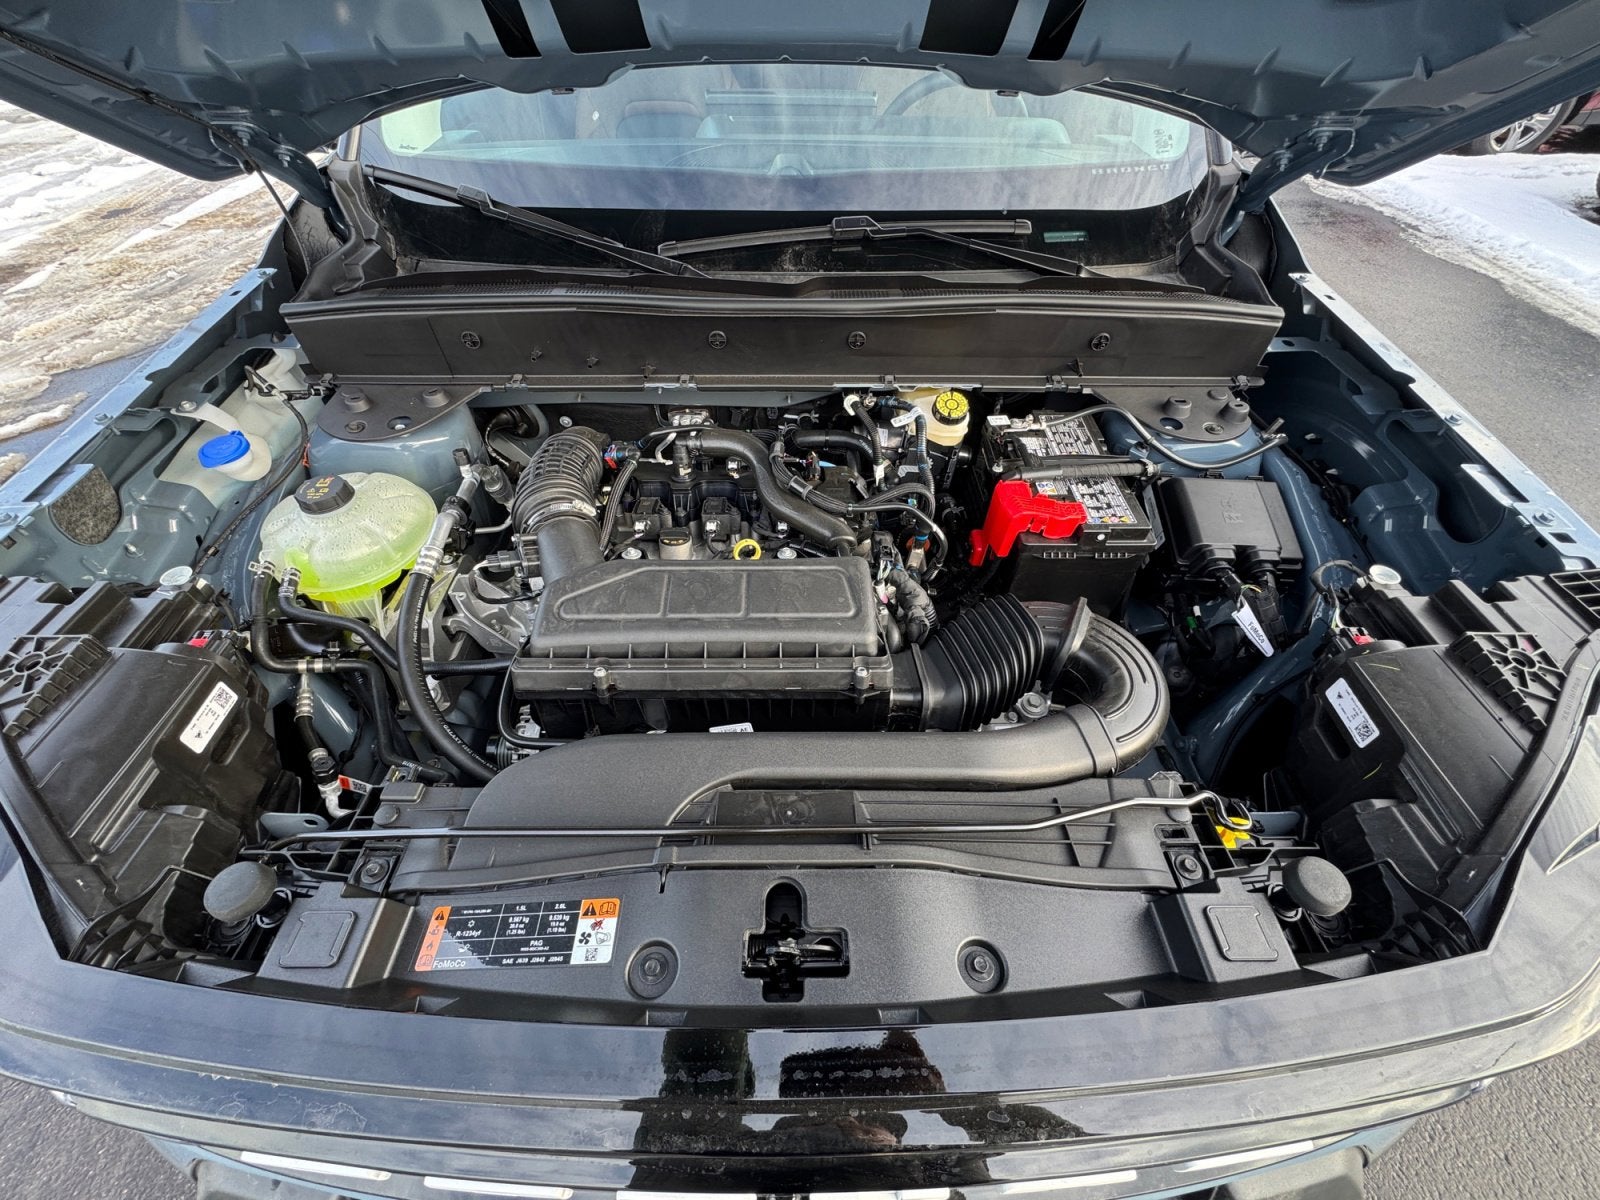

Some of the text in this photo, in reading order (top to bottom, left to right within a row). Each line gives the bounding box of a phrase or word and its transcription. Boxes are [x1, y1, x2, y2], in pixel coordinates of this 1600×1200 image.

[1091, 163, 1169, 175] BRONCO
[1247, 621, 1266, 645] FoMoCo
[455, 930, 482, 938] R-1234yf
[432, 959, 466, 969] FoMoCo
